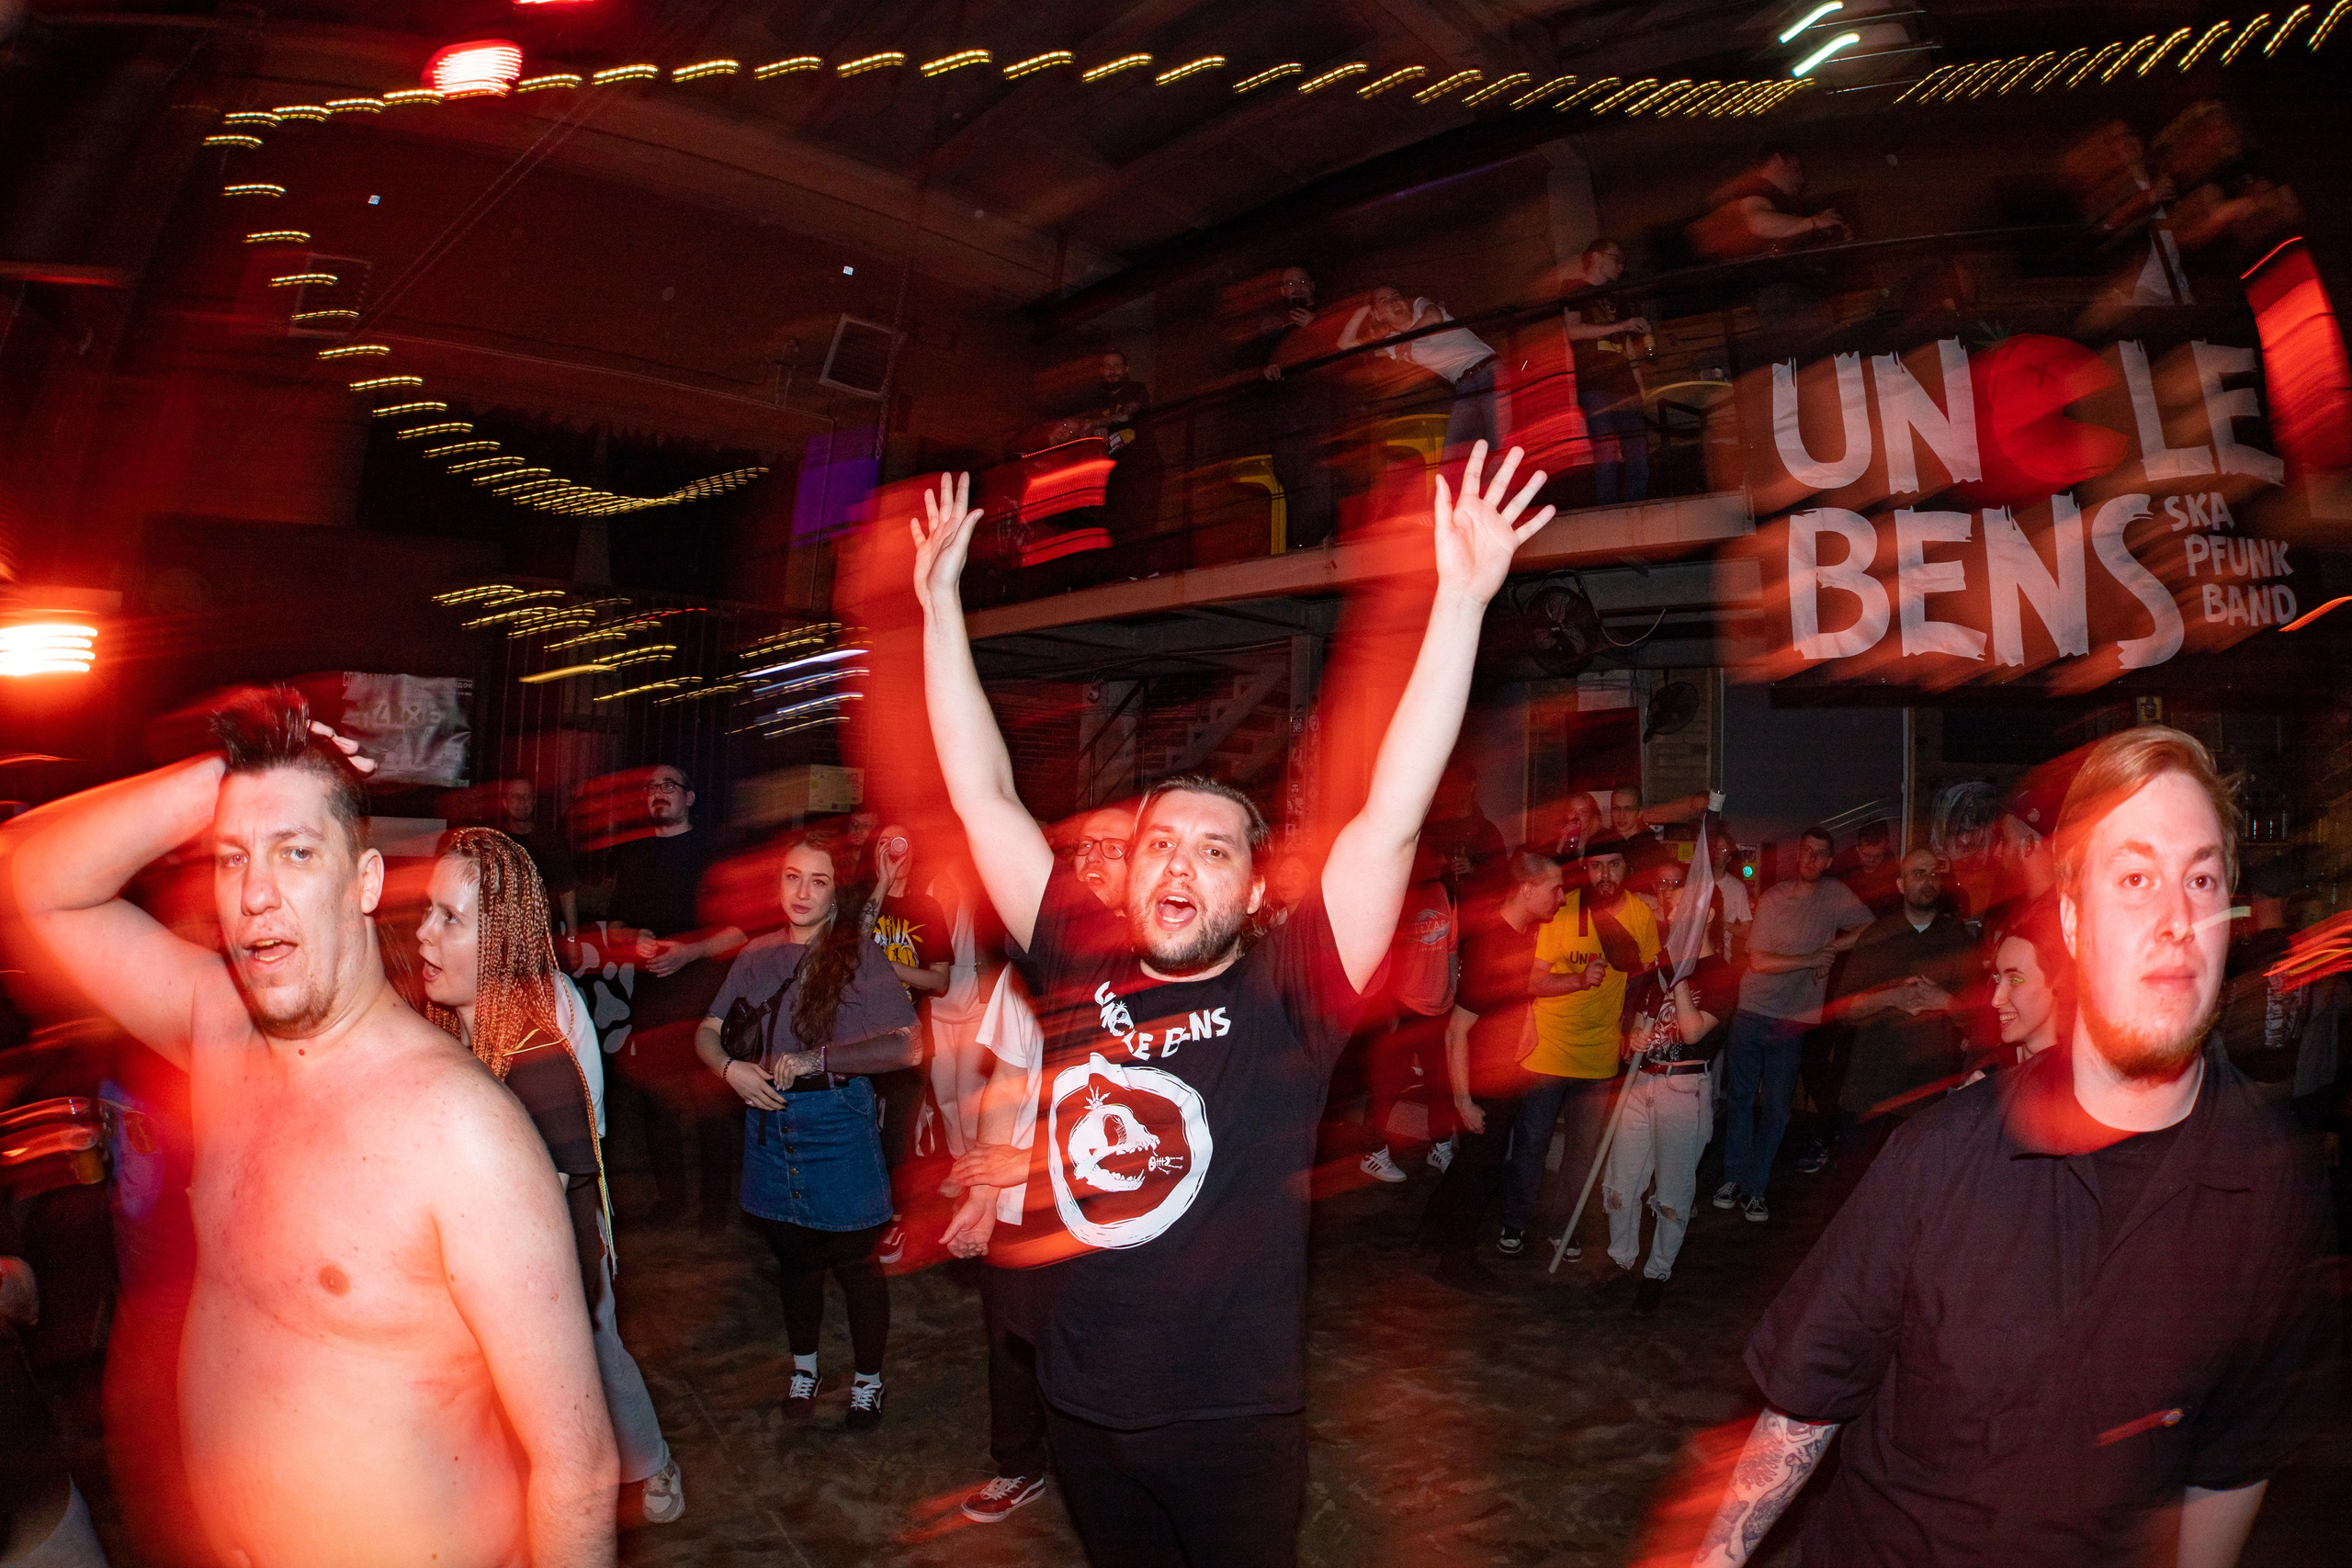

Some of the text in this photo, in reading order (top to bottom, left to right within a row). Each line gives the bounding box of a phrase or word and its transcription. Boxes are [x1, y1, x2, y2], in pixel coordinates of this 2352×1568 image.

[2164, 491, 2235, 532] SKA
[2184, 534, 2294, 580] PFUNK
[1789, 491, 2184, 669] BENS
[2202, 583, 2297, 627] BAND
